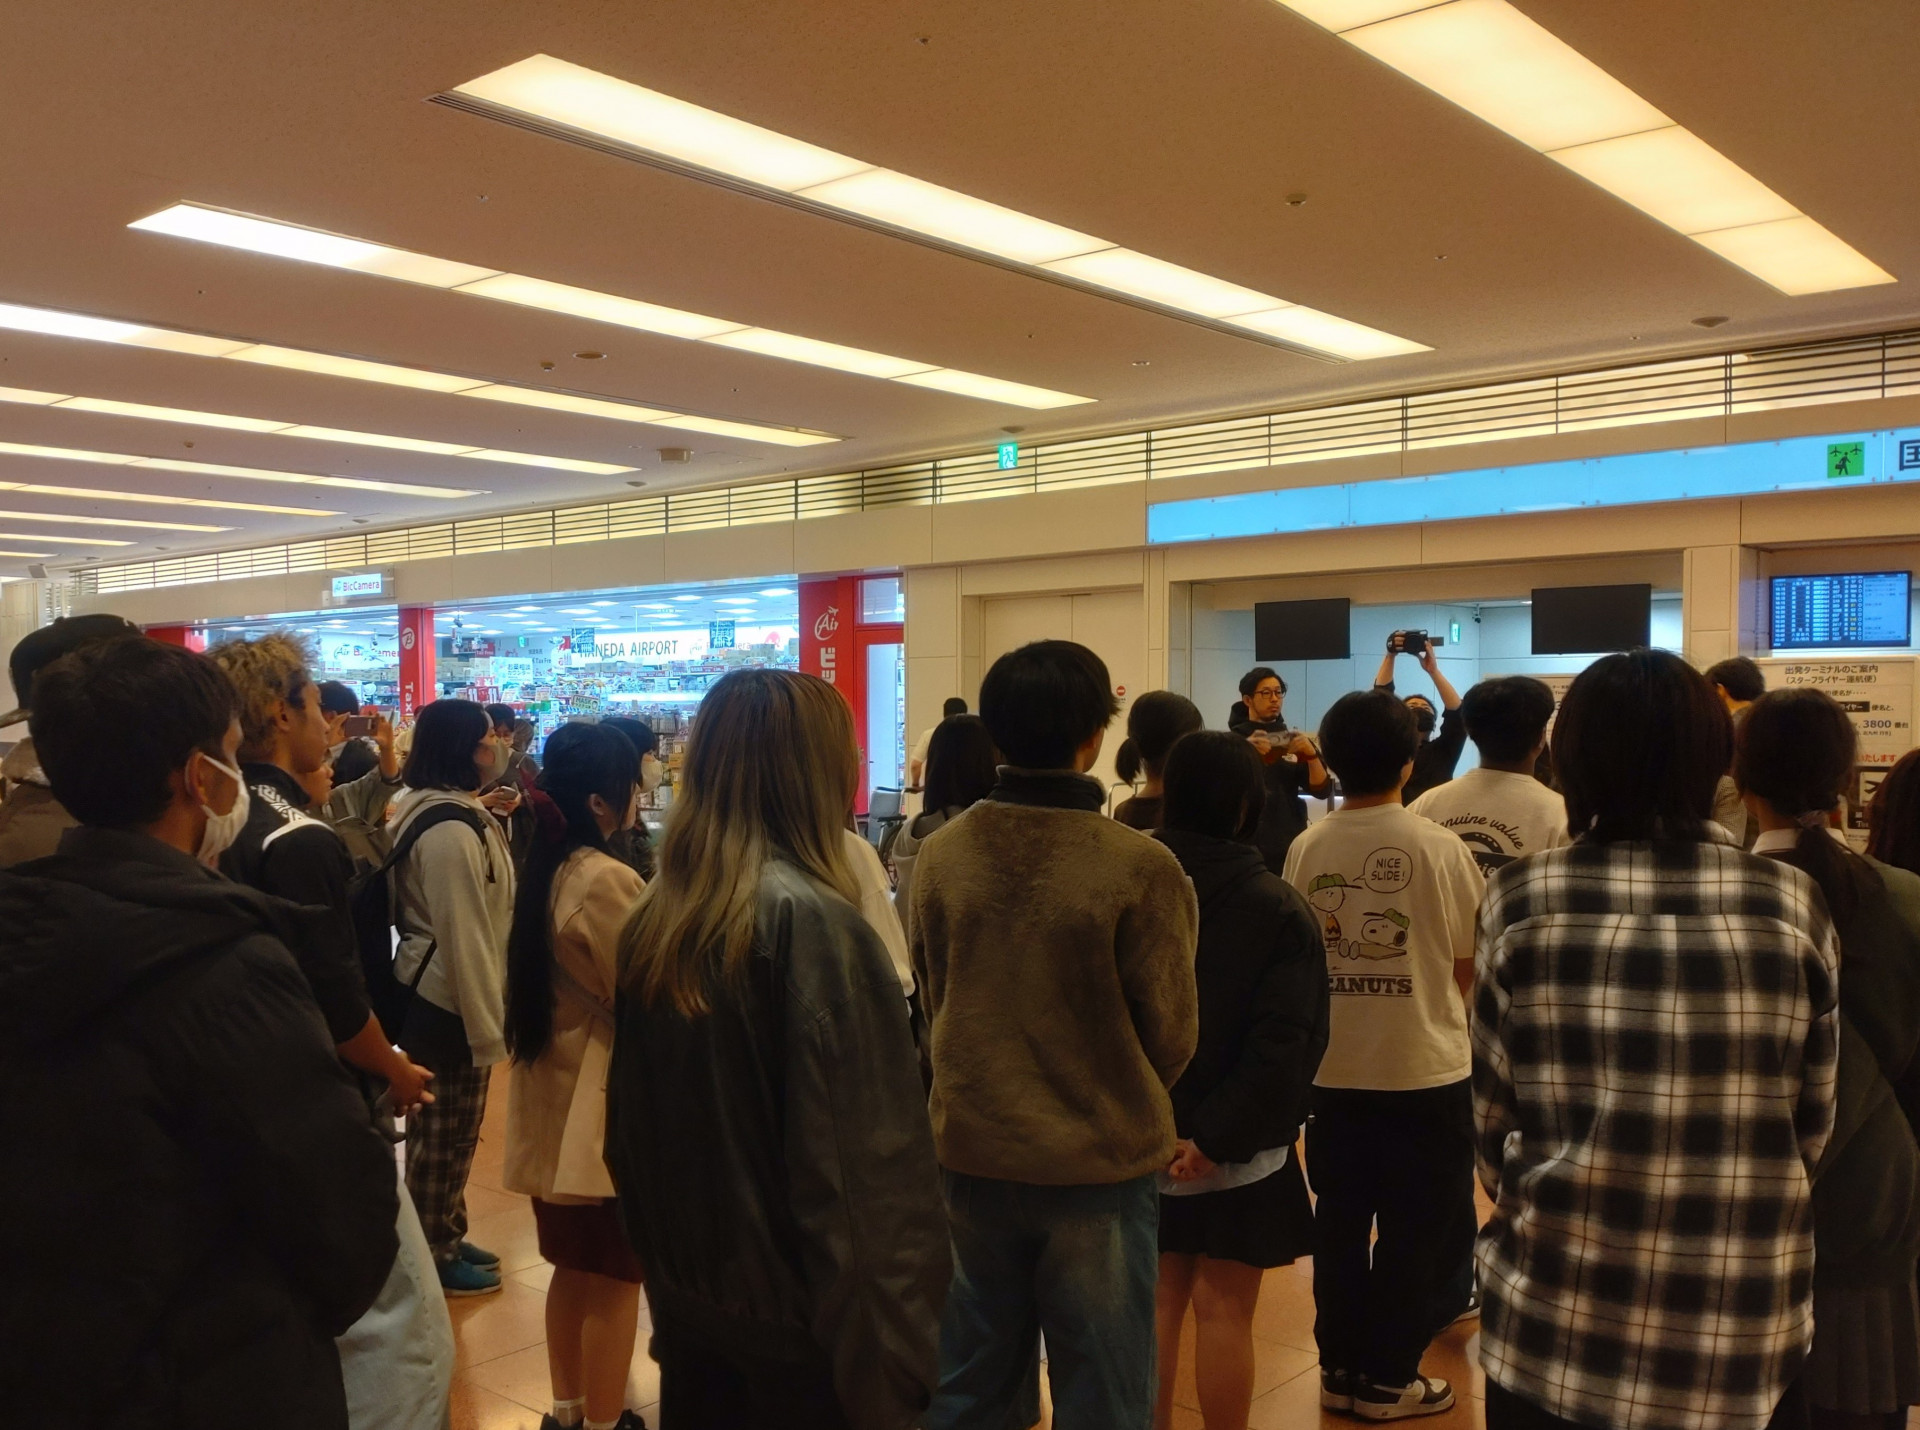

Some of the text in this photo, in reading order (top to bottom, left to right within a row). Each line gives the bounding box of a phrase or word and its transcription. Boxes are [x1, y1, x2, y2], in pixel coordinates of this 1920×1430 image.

[343, 581, 380, 591] BicCamera
[630, 640, 678, 656] AIRPORT
[1785, 664, 1878, 675] 出発ターミナルのご案内
[405, 682, 414, 712] Tax
[1863, 720, 1891, 728] 3800
[1439, 813, 1524, 850] nuine value
[1376, 858, 1401, 868] NICE
